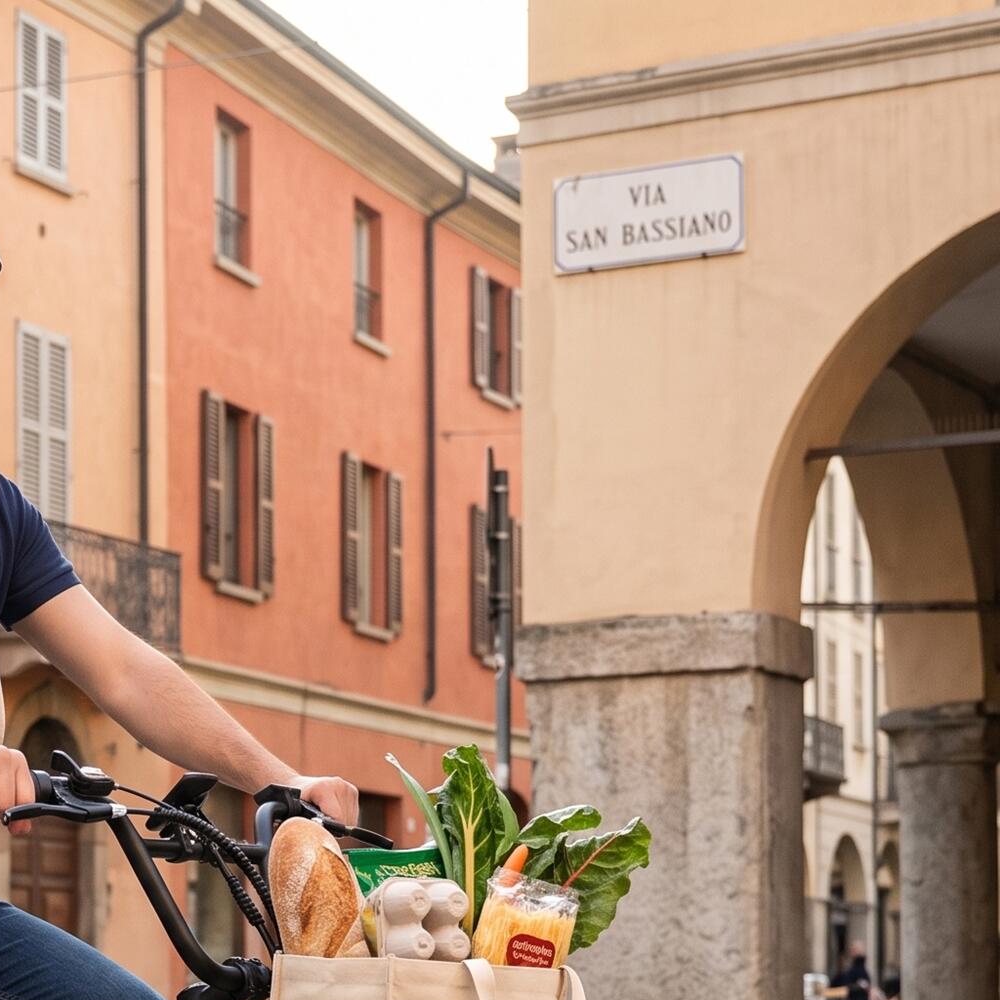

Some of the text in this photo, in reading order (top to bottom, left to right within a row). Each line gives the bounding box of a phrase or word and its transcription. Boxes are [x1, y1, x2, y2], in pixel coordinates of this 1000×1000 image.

[629, 184, 666, 206] VIA
[566, 210, 732, 253] SAN BASSIANO
